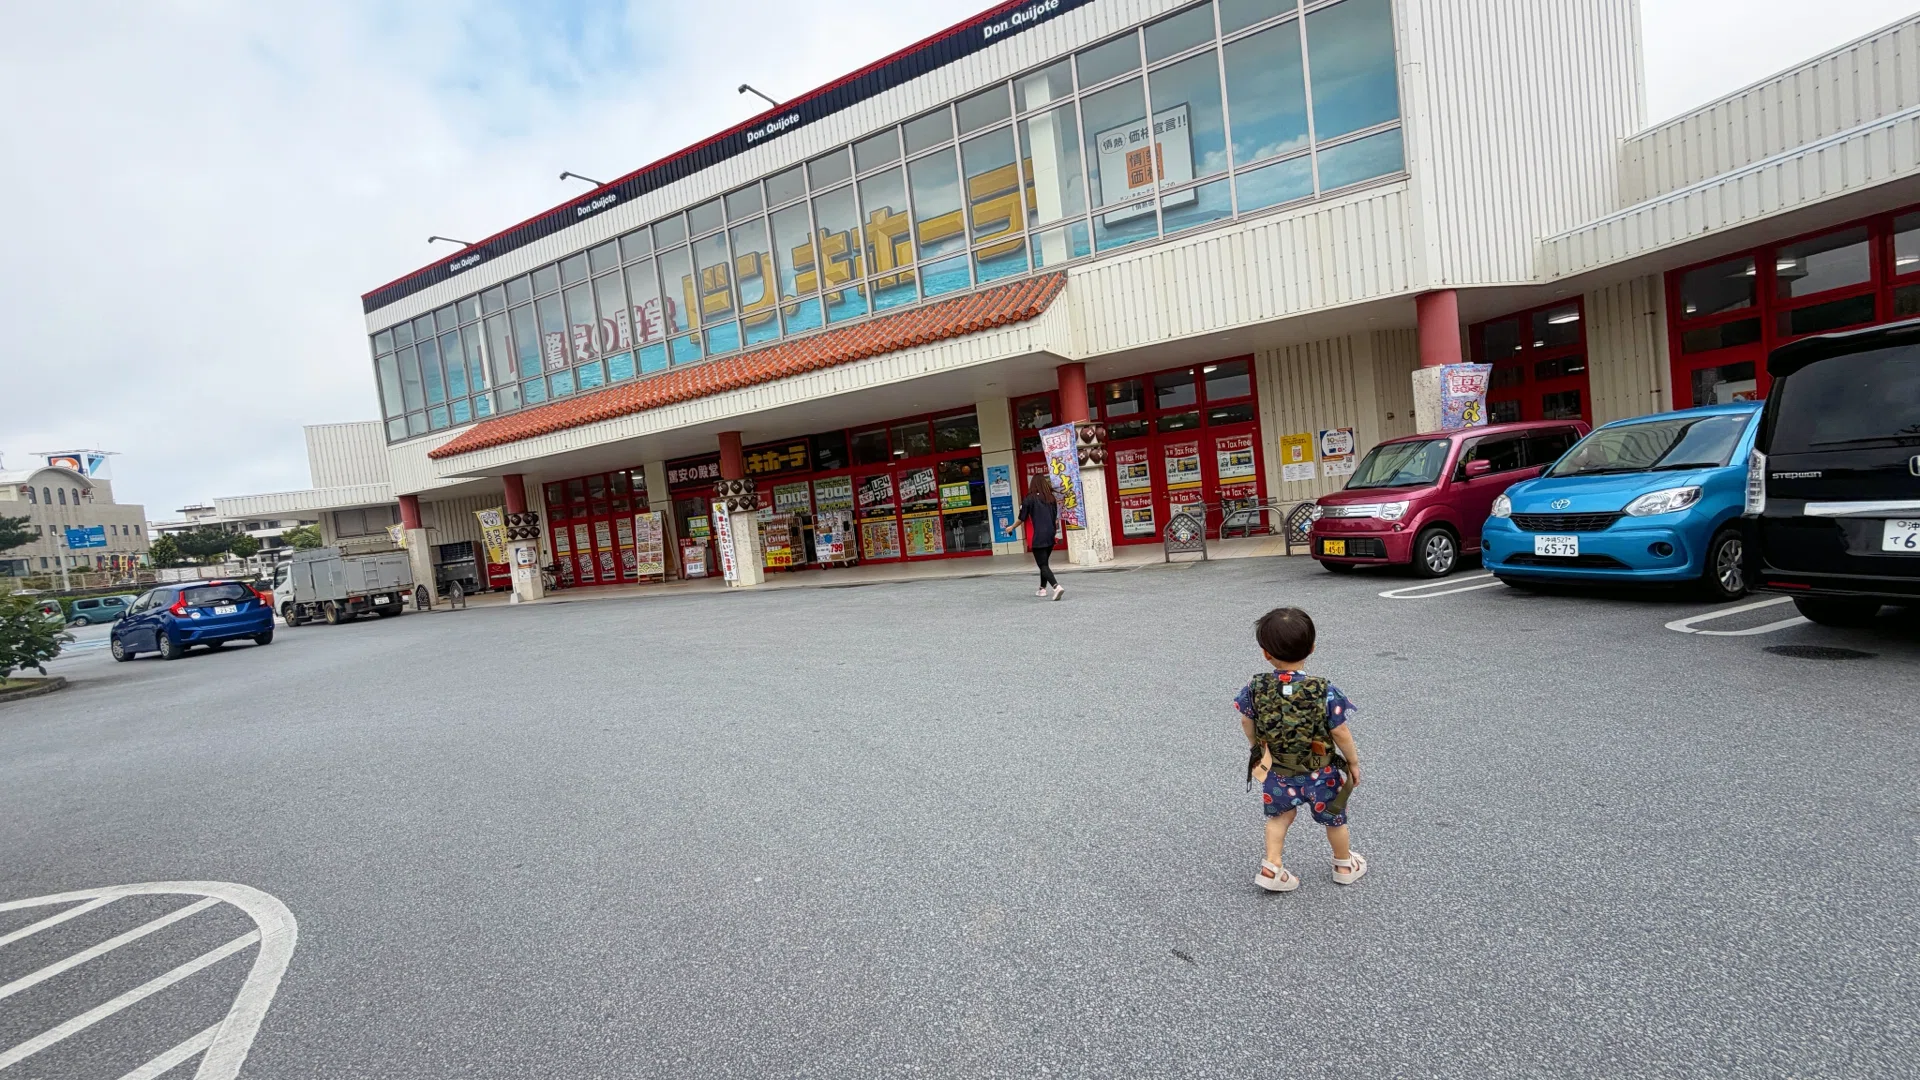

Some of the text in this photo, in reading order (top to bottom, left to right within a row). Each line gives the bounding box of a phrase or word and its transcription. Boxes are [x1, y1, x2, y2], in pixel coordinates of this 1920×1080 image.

[983, 0, 1059, 39] Don Quijote
[746, 113, 800, 143] Don Quijote
[577, 194, 617, 217] Don Quijote
[450, 254, 480, 272] Don Quijote
[544, 296, 679, 370] 驚安の殿堂
[1227, 440, 1237, 449] Tax
[1238, 439, 1252, 447] Free
[1174, 447, 1184, 456] Tax
[1184, 446, 1197, 454] Free
[1125, 454, 1134, 462] Tax
[1134, 453, 1147, 461] Free
[668, 463, 720, 484] 驚安の殿堂
[914, 470, 933, 485] U24
[872, 476, 890, 490] U24
[1231, 488, 1241, 496] Tax
[1129, 499, 1140, 507] Tax
[1139, 498, 1152, 506] Free
[1179, 494, 1189, 502] Tax
[830, 543, 843, 552] 799
[1544, 544, 1576, 555] 65-75
[773, 556, 791, 564] 198
